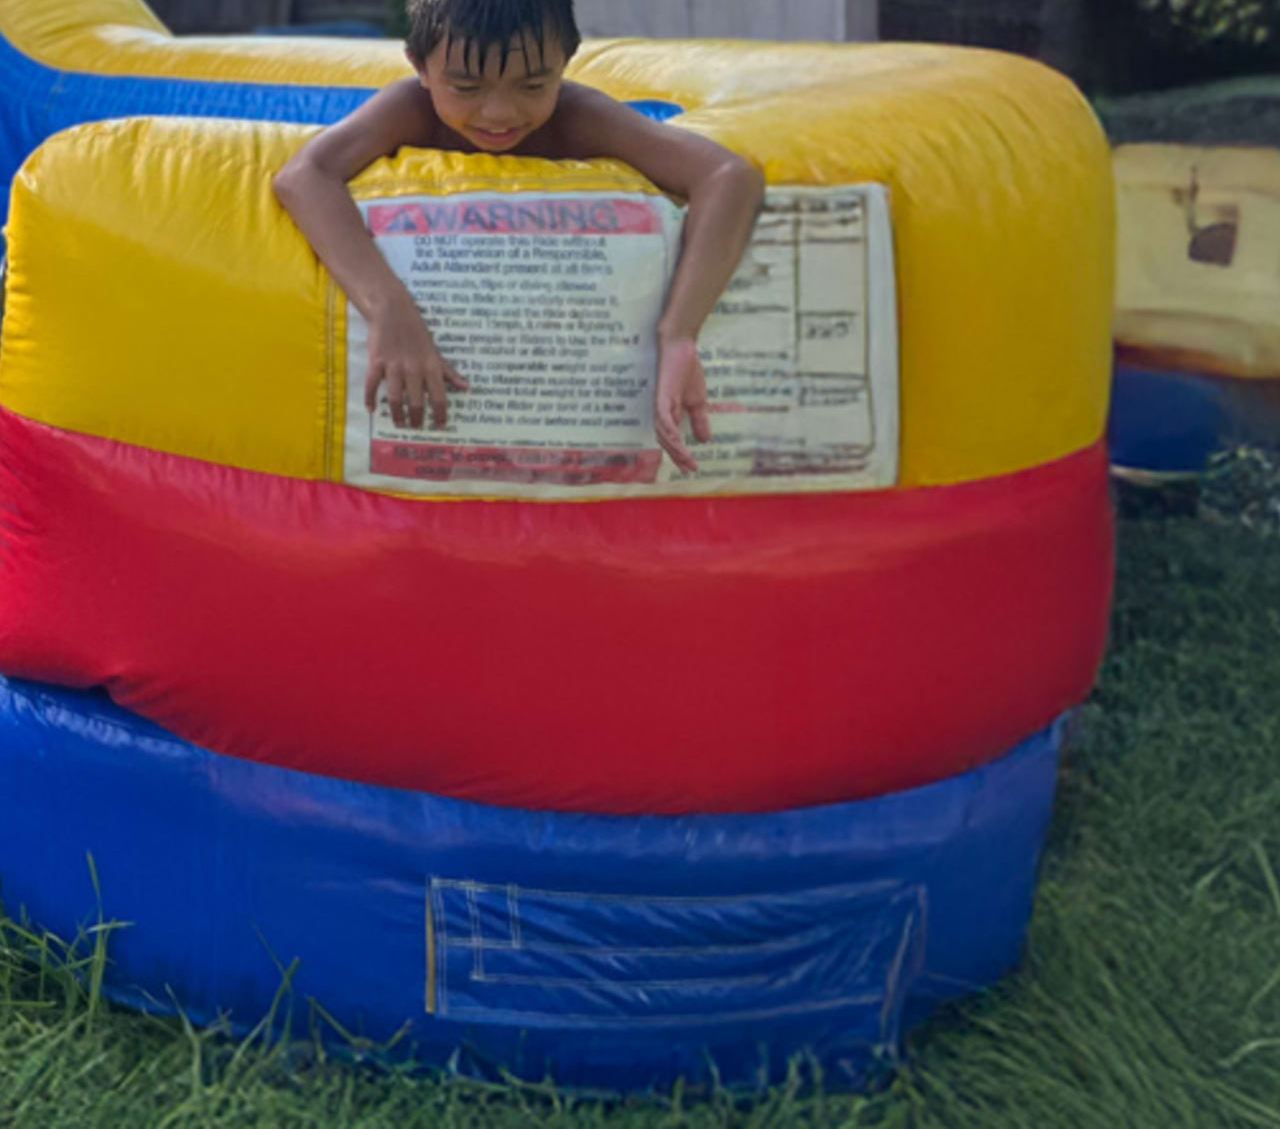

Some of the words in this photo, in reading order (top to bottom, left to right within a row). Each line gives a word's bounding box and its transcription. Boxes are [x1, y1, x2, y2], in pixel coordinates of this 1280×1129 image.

[426, 202, 619, 231] WARNING
[415, 235, 431, 246] DO
[434, 235, 457, 246] NOT
[461, 237, 505, 248] operate
[508, 236, 530, 247] this
[563, 237, 606, 248] without
[416, 248, 434, 259] the
[437, 247, 505, 261] Supervision
[507, 247, 520, 259] of
[410, 261, 442, 273] Adult
[444, 261, 501, 274] Attendant
[503, 263, 548, 277] present
[438, 333, 466, 343] allow
[486, 359, 548, 374] comparable
